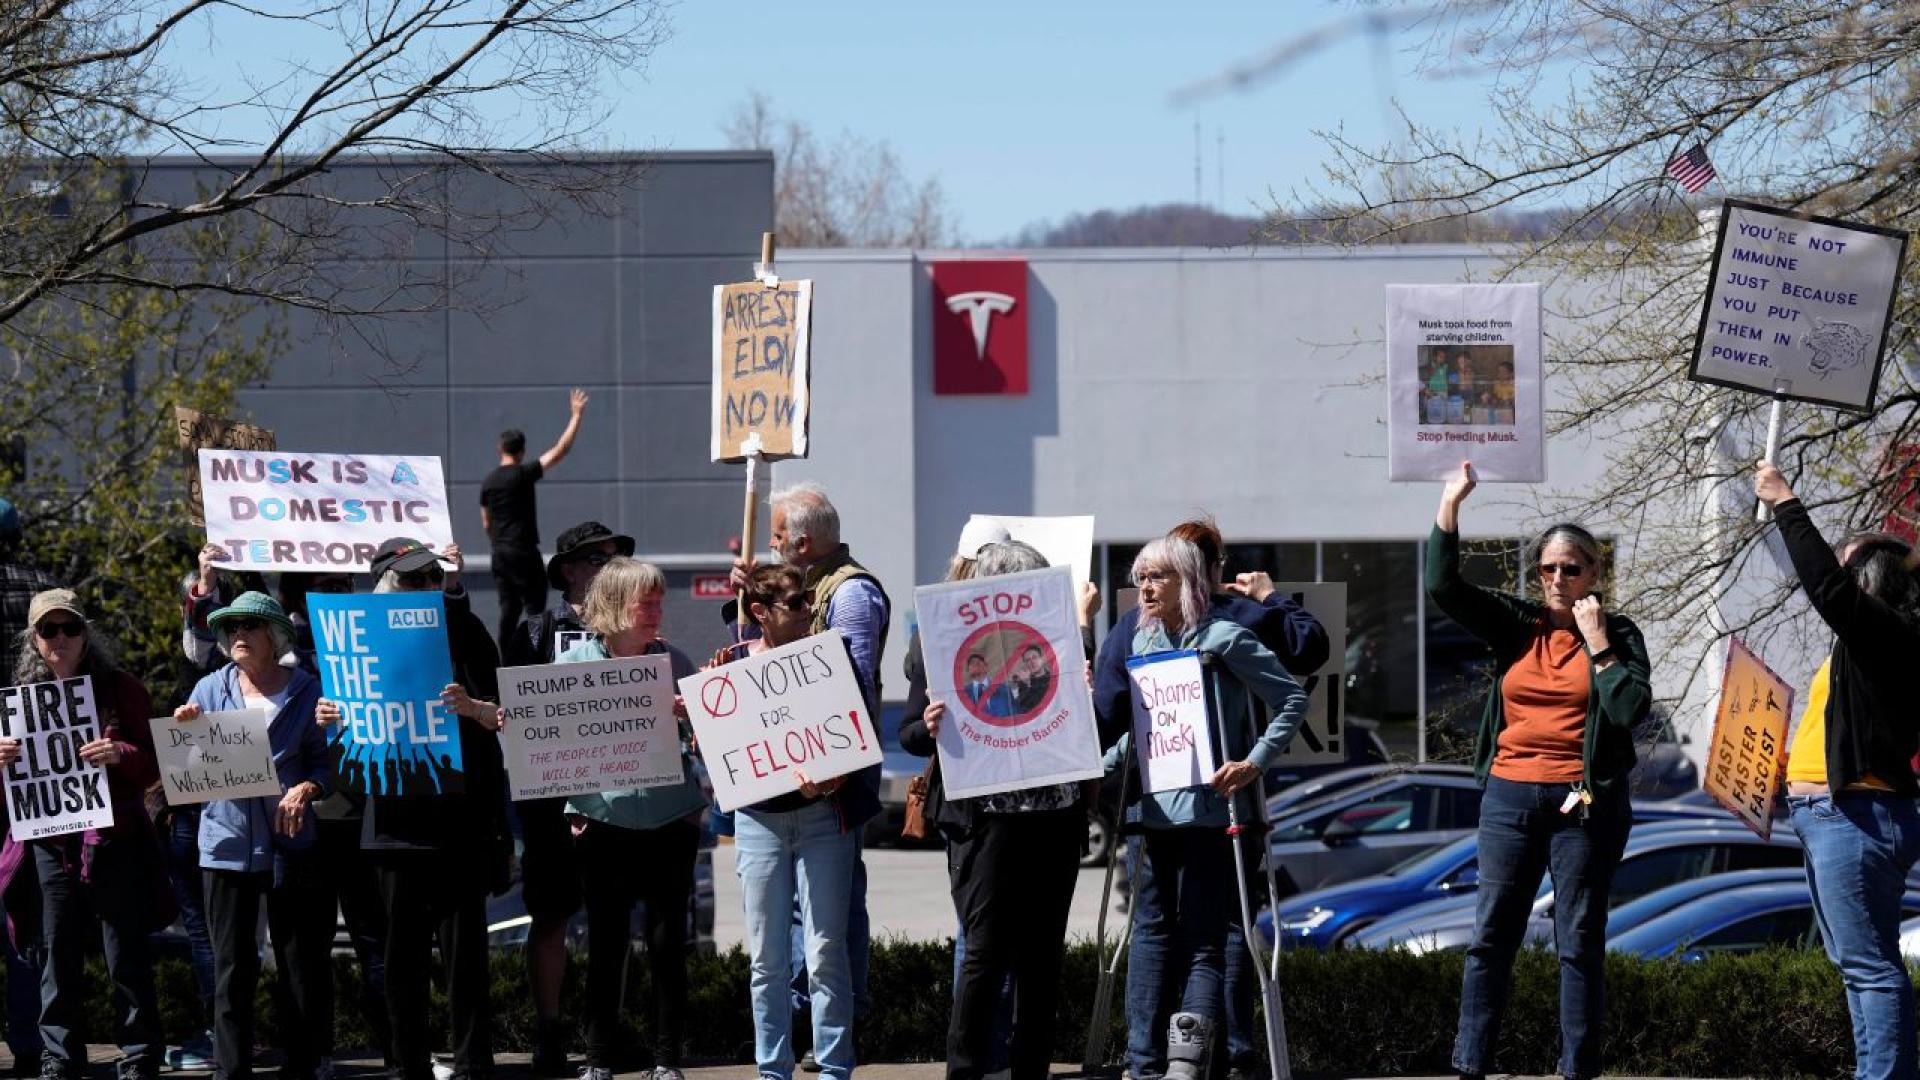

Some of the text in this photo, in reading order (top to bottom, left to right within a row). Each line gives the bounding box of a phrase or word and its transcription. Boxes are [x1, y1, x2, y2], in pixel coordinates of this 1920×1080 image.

[1739, 223, 1847, 255] YOU'RE NOT
[1732, 248, 1799, 271] IMMUNE
[1727, 272, 1858, 305] JUST BECAUSE
[723, 289, 801, 335] ARREST
[1723, 297, 1800, 322] YOU PUT
[1419, 320, 1512, 328] Musk took food from
[1426, 332, 1505, 343] starving children.
[1718, 321, 1791, 346] THEM IN
[1711, 346, 1773, 368] POWER.
[725, 390, 798, 438] NOW
[1417, 432, 1518, 443] Stop feeding Musk.
[211, 459, 419, 485] MUSK IS A
[229, 496, 430, 523] DOMESTIC
[391, 610, 435, 626] ACLU
[958, 592, 1033, 625] STOP
[318, 609, 369, 653] WE
[324, 655, 383, 699] THE
[517, 666, 658, 696] tRUMP & fELON
[745, 644, 832, 699] VOTES
[1138, 676, 1201, 711] Shame
[0, 678, 92, 738] FIRE
[335, 700, 448, 744] PEOPLE
[504, 695, 653, 721] ARE DESTROYING
[760, 706, 794, 728] FOR
[524, 717, 657, 740] OUR COUNTRY
[960, 708, 1070, 748] The Robber Barons
[199, 751, 223, 764] the
[529, 751, 552, 765] THE
[613, 740, 648, 756] VOICE
[722, 710, 868, 786] FELONS!
[1715, 734, 1735, 790] FAST
[542, 759, 640, 782] WILL BE HEARD
[1732, 725, 1758, 804] FASTER
[1750, 728, 1776, 819] FASCIST
[170, 771, 218, 794] White
[555, 785, 570, 793] you
[572, 783, 584, 791] by
[628, 774, 681, 785] Amendment
[10, 772, 106, 822] MUSK
